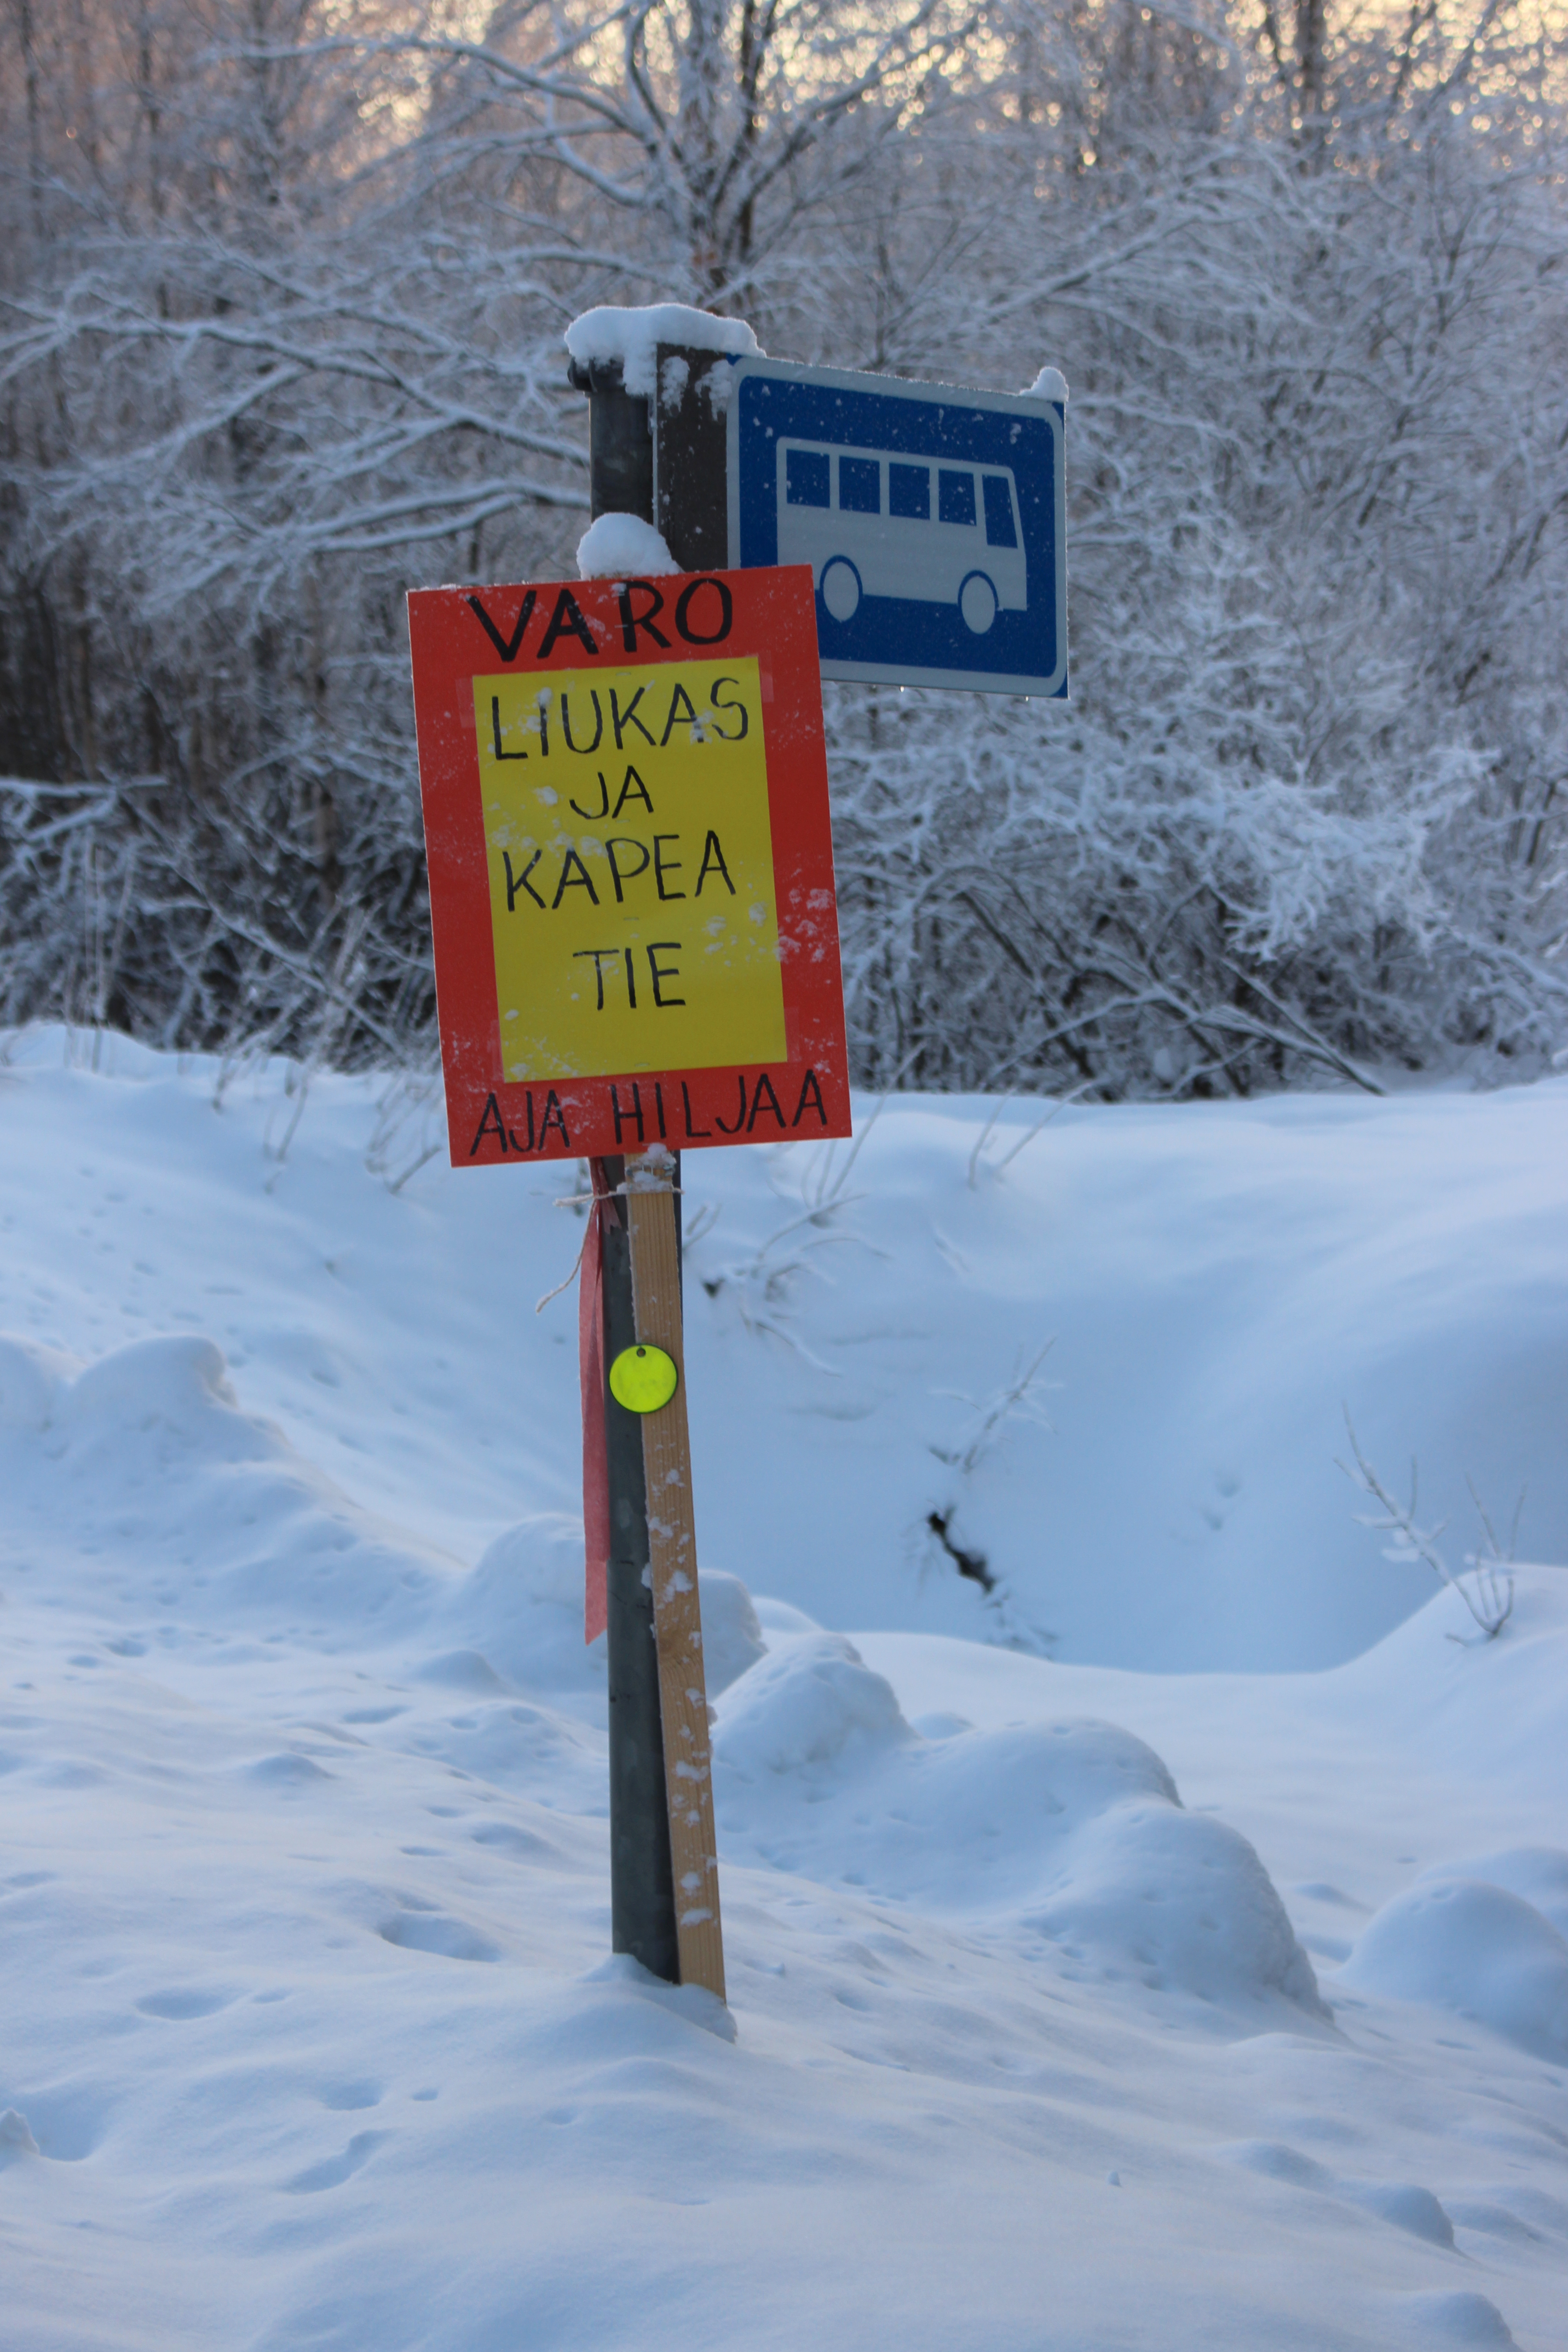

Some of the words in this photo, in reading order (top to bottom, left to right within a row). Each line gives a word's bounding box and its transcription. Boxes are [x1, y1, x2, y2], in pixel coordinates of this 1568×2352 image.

[466, 578, 733, 663] VARO
[491, 677, 749, 761] LIUKAS
[568, 765, 655, 819] JA
[502, 829, 736, 912] KAPEA
[572, 942, 686, 1011] TIE
[469, 1089, 571, 1156] AJA
[610, 1069, 828, 1145] HILJAA
